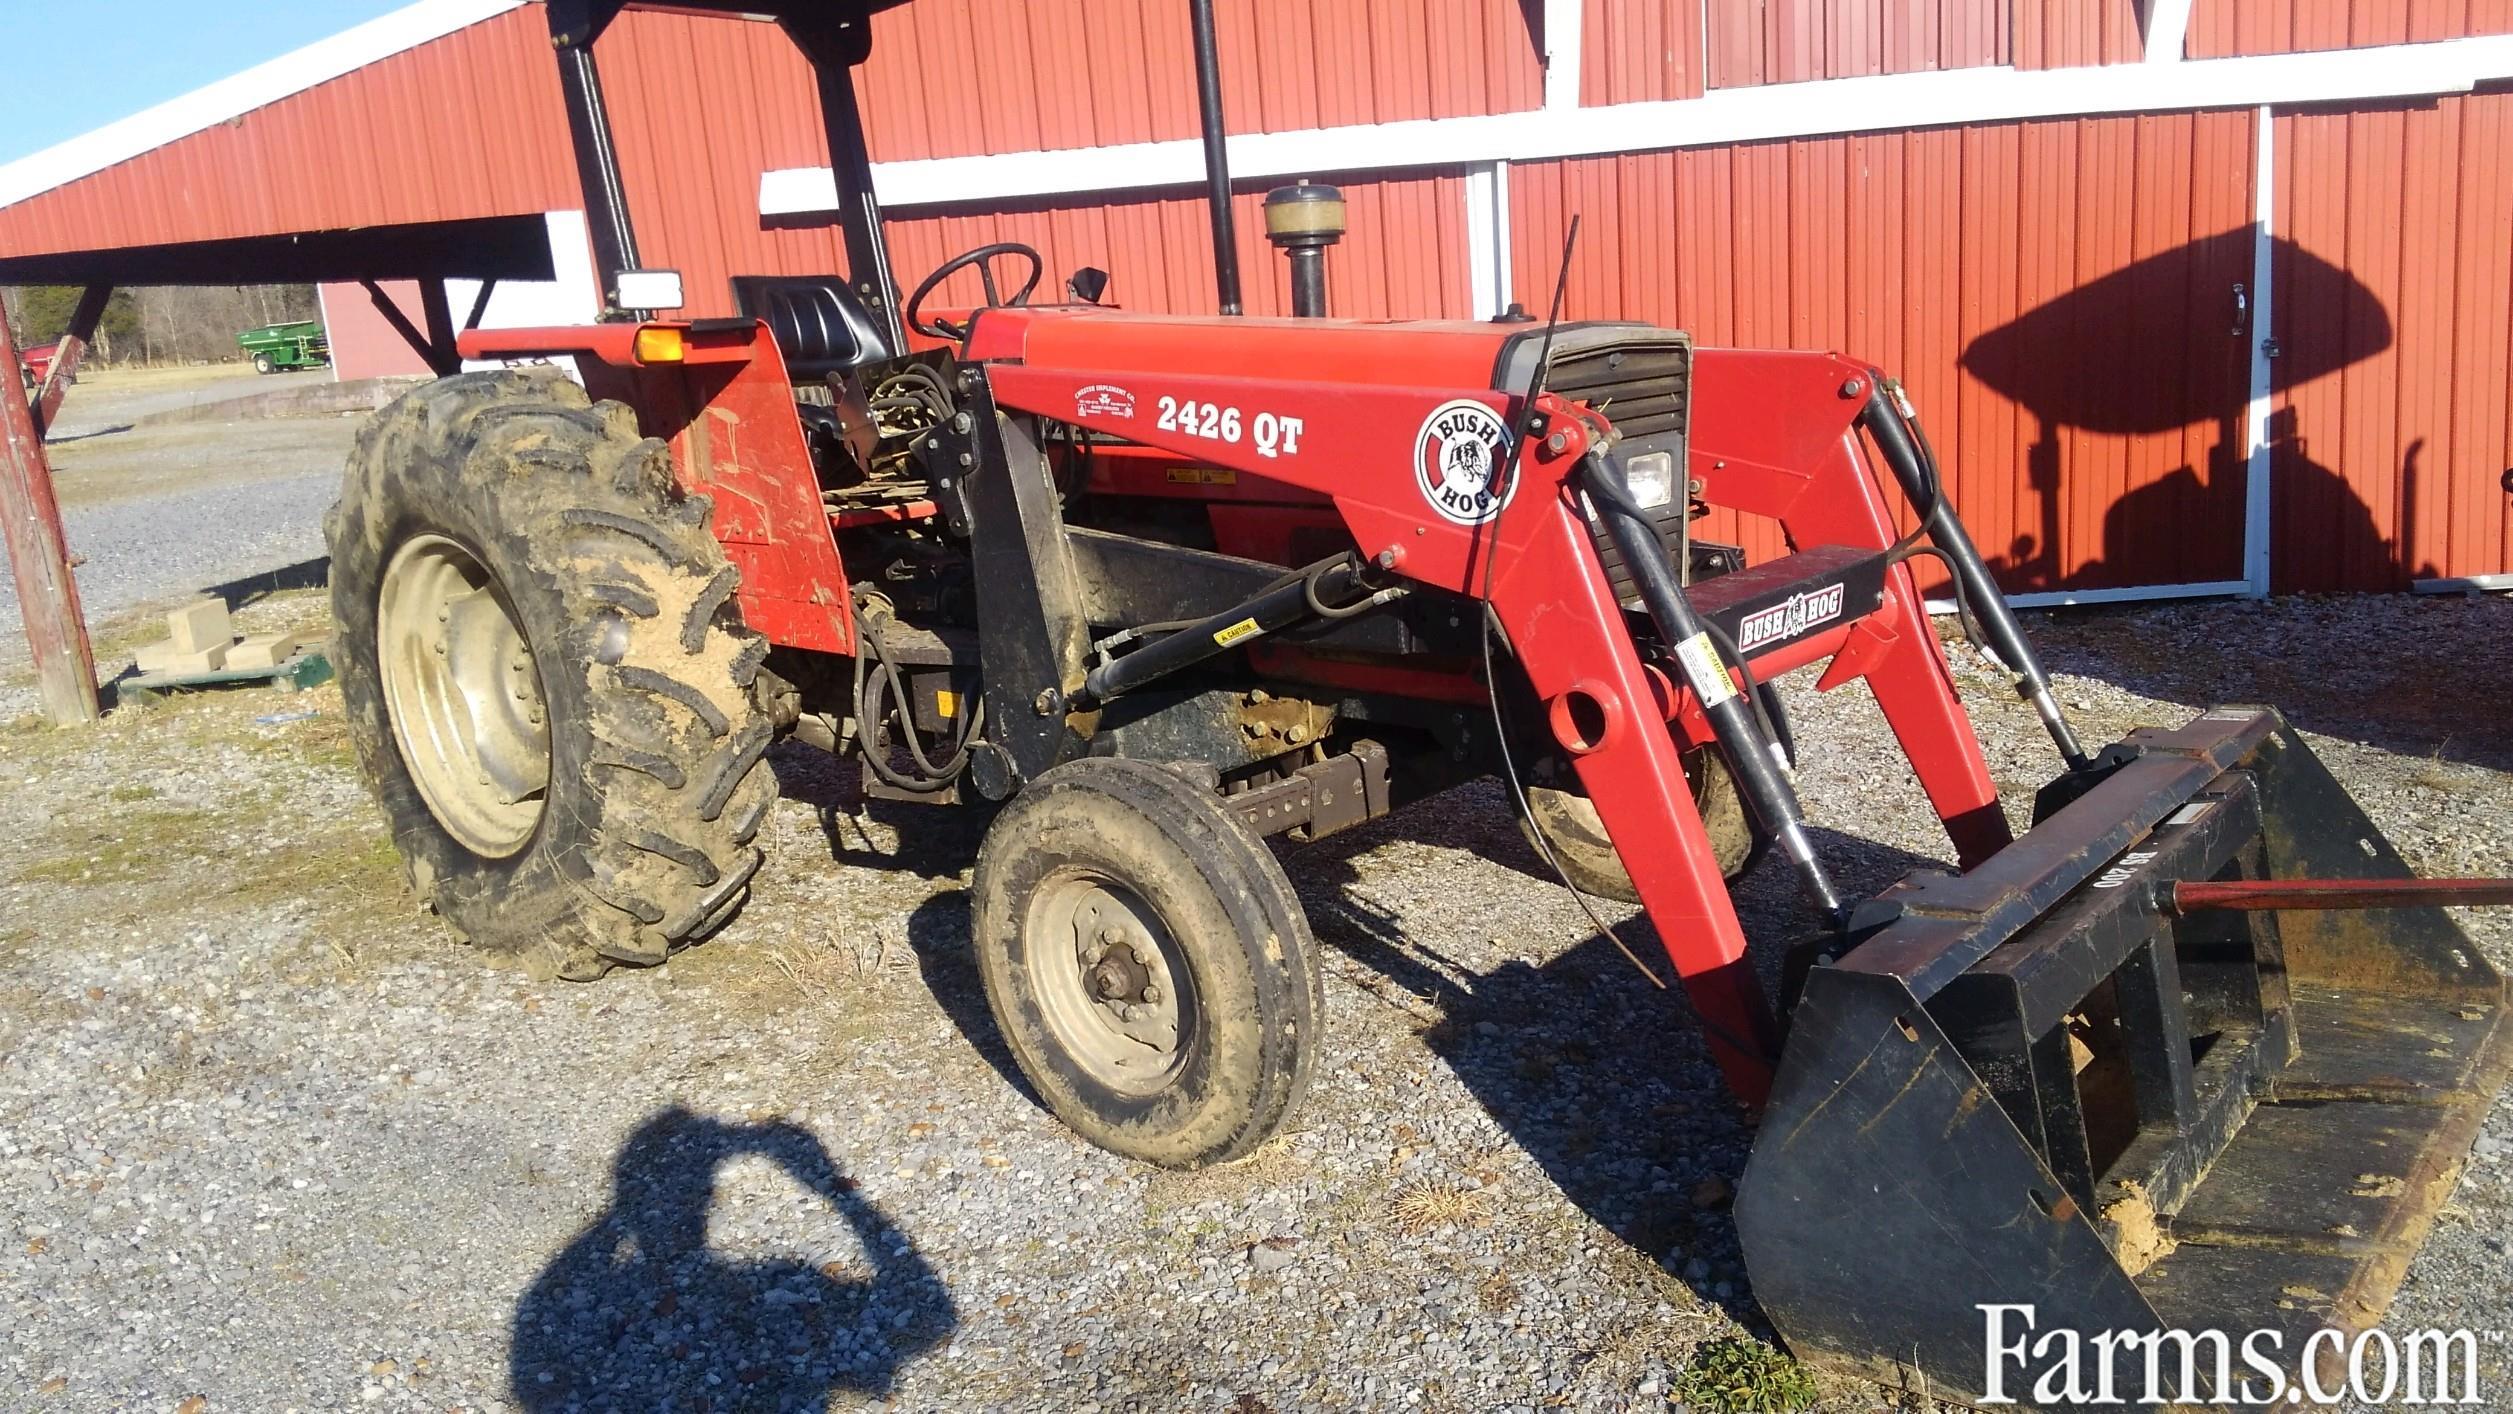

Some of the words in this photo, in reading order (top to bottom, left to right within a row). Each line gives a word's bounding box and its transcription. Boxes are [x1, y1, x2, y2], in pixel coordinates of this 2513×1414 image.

[1157, 395, 1242, 443] 2426
[1253, 412, 1303, 458] QT
[1438, 413, 1497, 445] BUSH
[1441, 486, 1489, 512] HOG
[1227, 623, 1252, 638] CAUTION
[1743, 609, 1784, 646] BUSH
[1807, 591, 1839, 622] HOG
[2092, 867, 2139, 888] 200
